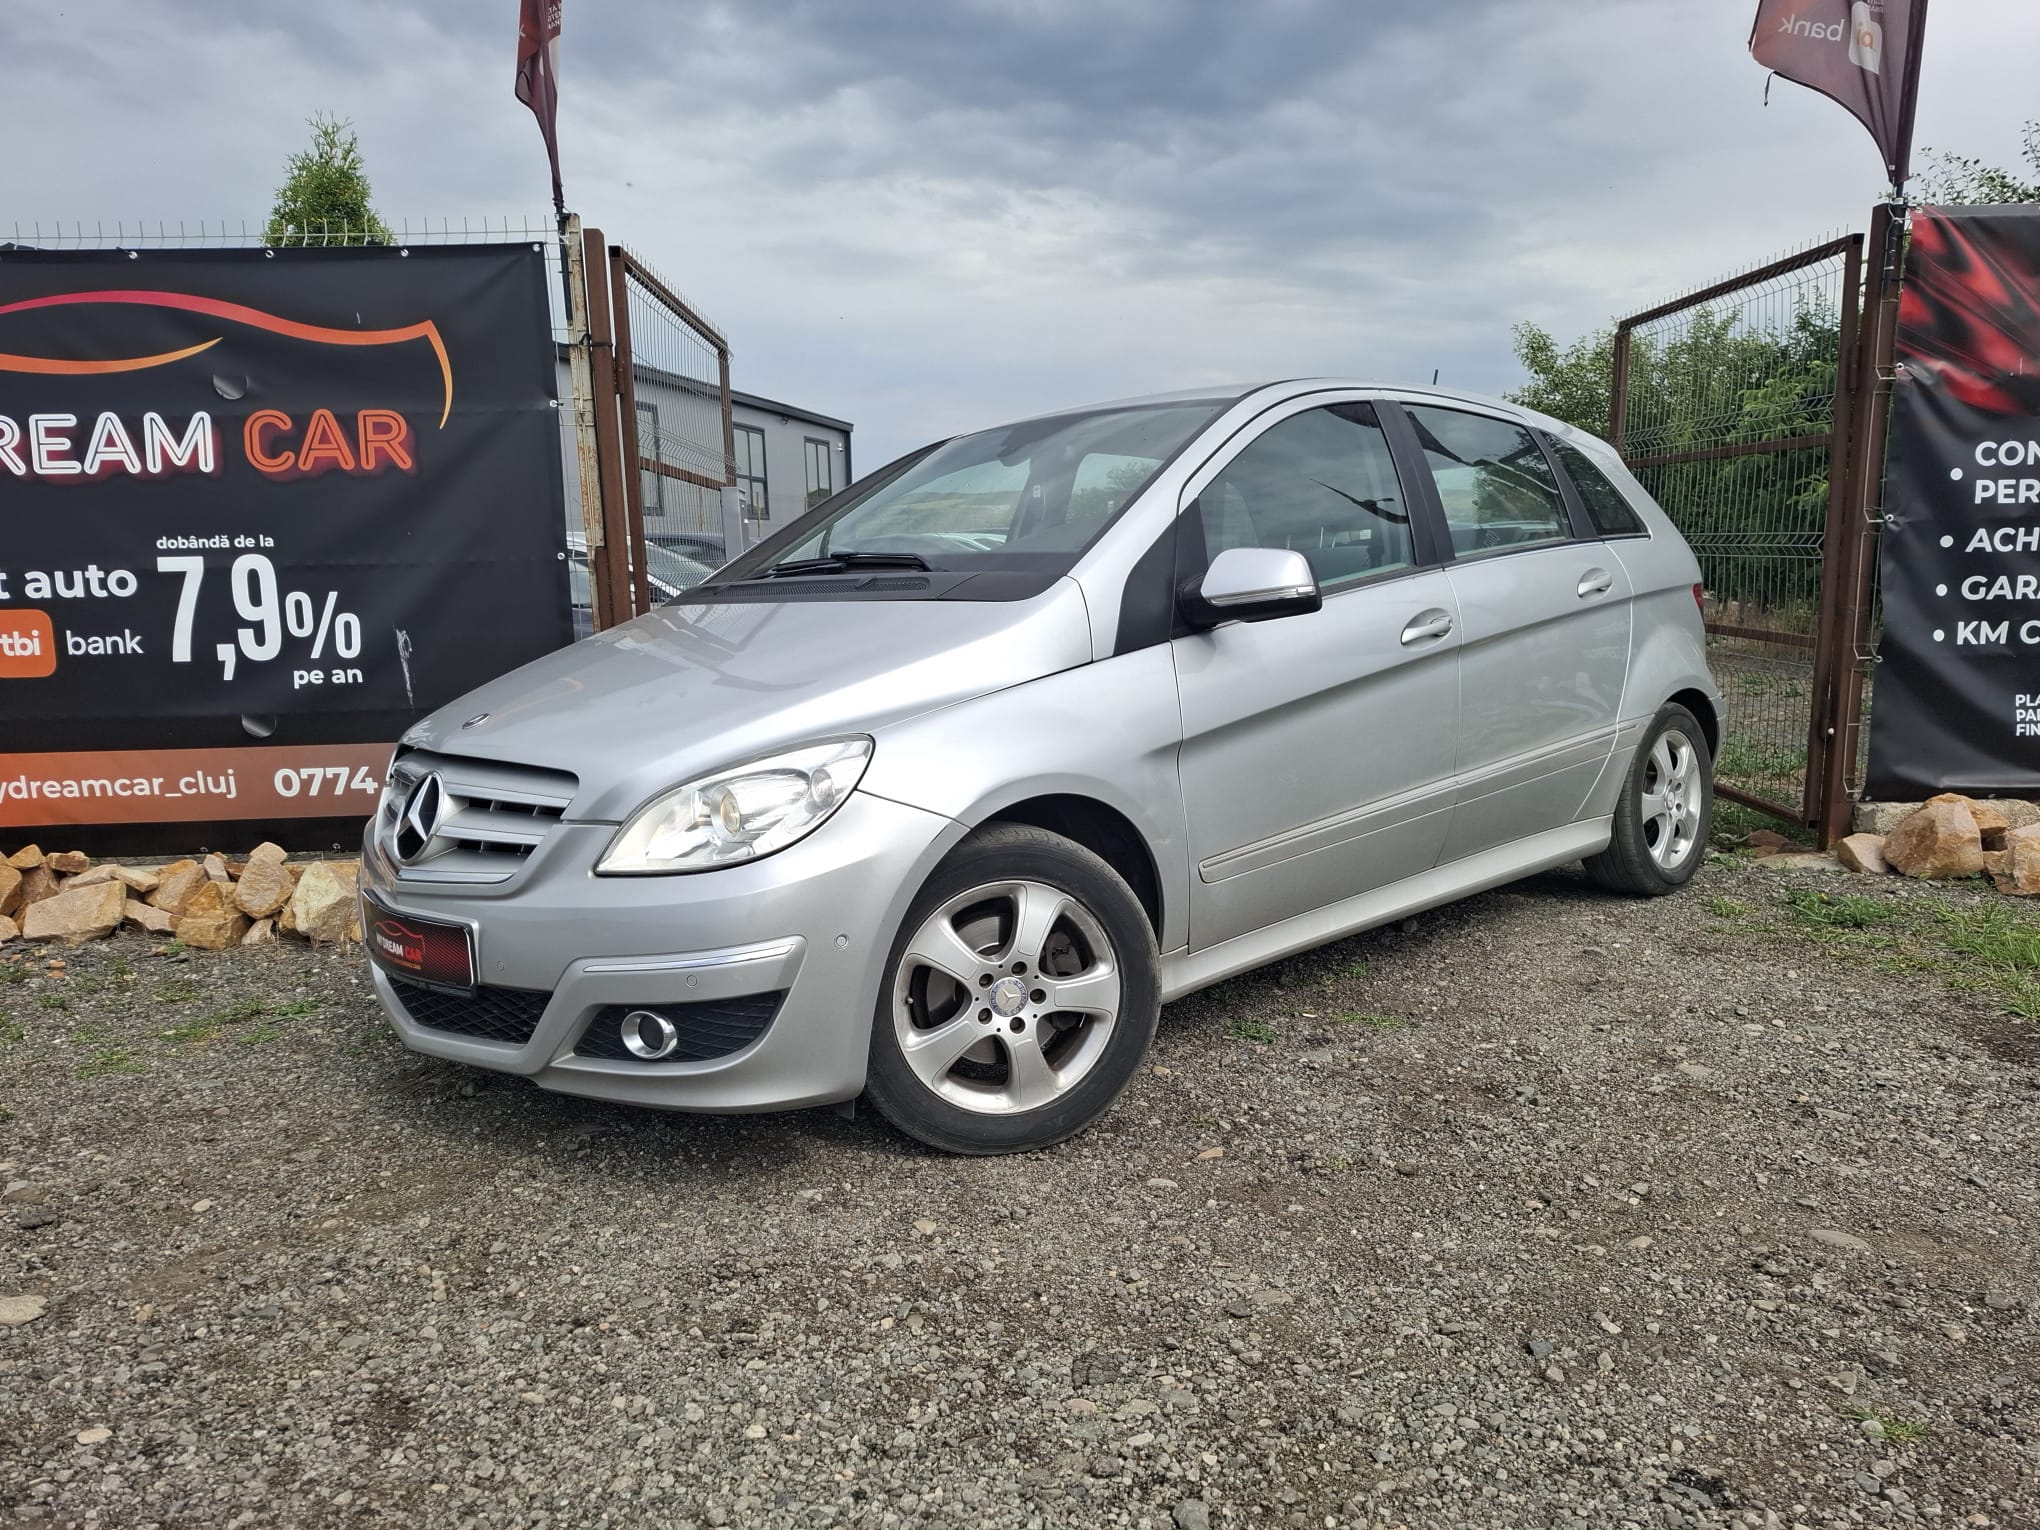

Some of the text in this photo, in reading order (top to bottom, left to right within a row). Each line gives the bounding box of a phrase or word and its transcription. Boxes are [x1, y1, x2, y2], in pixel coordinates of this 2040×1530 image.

[243, 408, 413, 472] CAR
[1974, 478, 2040, 504] PER
[156, 534, 275, 549] dobândă de la
[1964, 527, 2040, 552] ACH
[24, 564, 138, 599] auto
[1961, 574, 2040, 600] GAR
[156, 553, 362, 681] 7,9%
[0, 628, 144, 656] tbi bank
[1956, 620, 2010, 645] KM
[293, 668, 363, 689] pe an
[274, 766, 378, 798] 0774
